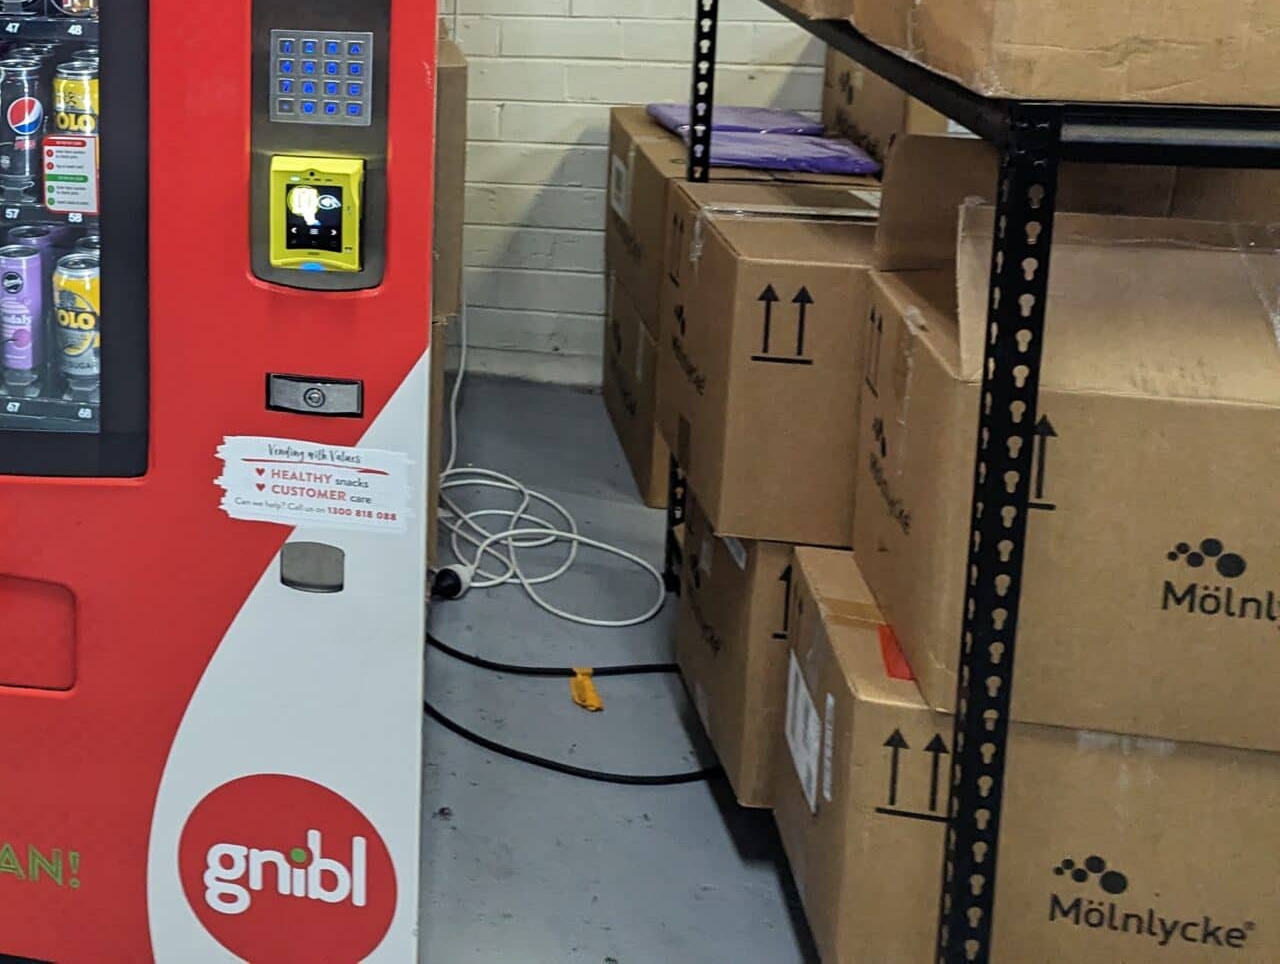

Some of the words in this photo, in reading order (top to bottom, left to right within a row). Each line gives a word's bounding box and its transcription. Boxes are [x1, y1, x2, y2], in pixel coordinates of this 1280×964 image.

[6, 22, 20, 33] 47
[68, 24, 82, 36] 48
[5, 208, 19, 219] 57
[68, 213, 83, 223] 58
[6, 402, 21, 413] 67
[78, 408, 93, 419] 68
[268, 443, 305, 463] Vending
[307, 448, 329, 461] with
[330, 449, 361, 464] Values
[271, 468, 333, 485] HEALTHY
[335, 476, 369, 489] snacks
[271, 484, 347, 502] CUSTOMER
[350, 495, 373, 505] care
[234, 496, 252, 505] Can
[287, 502, 304, 511] Call
[327, 506, 353, 516] 1300
[1160, 579, 1280, 622] Mölnl
[203, 828, 368, 915] gnibl
